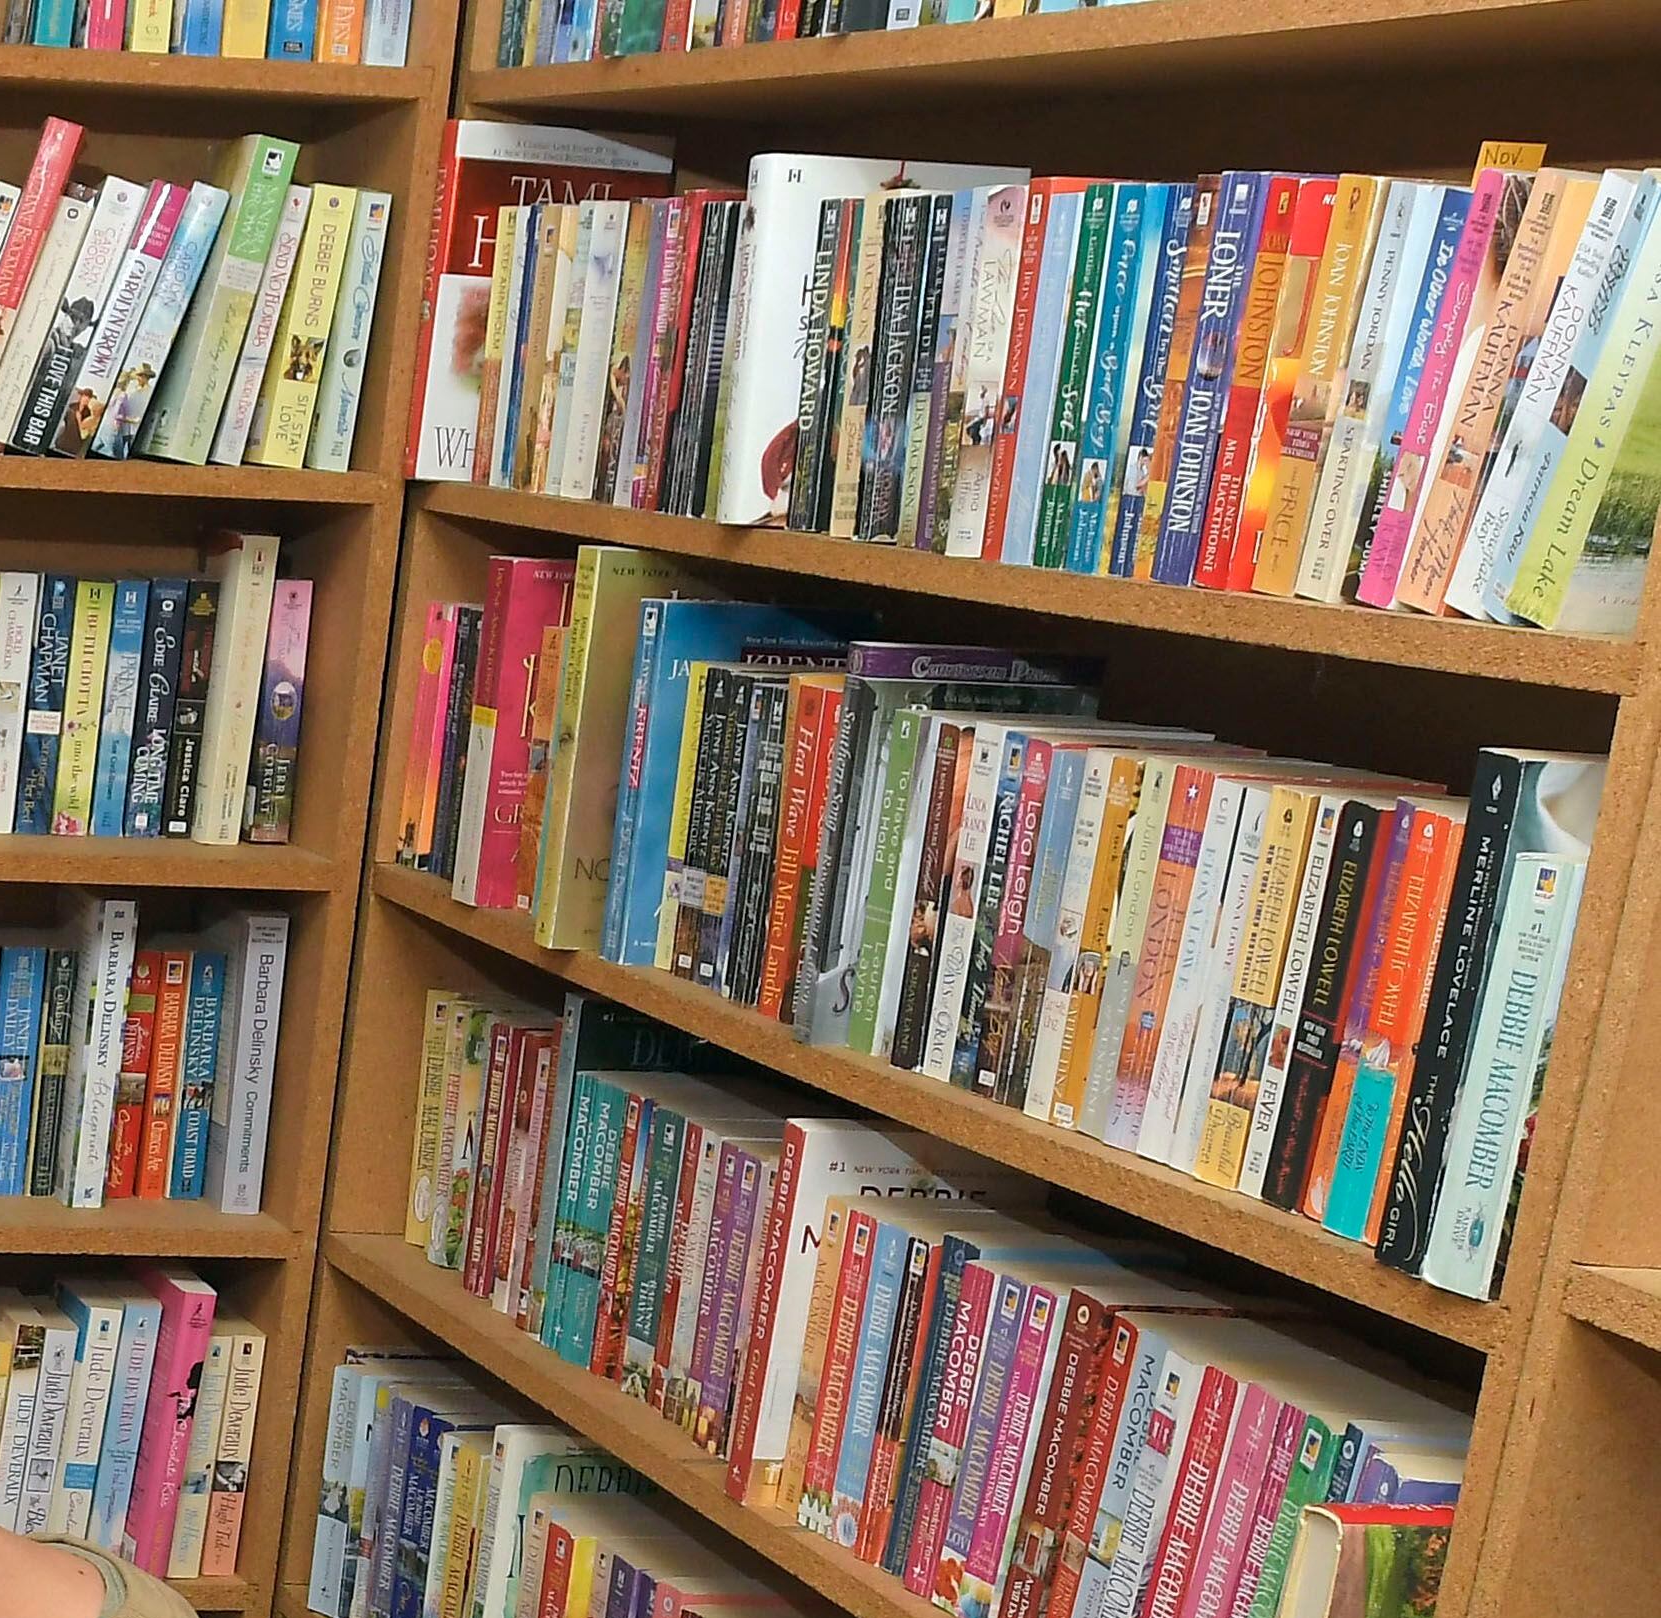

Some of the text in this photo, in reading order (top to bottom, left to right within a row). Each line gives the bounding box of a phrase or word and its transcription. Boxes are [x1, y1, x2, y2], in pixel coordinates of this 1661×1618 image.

[1484, 146, 1524, 168] Nov.
[1199, 231, 1243, 322] LONER
[1238, 255, 1274, 380] JOHNSTON
[21, 355, 71, 446] LOVE THIS BAR
[798, 250, 833, 434] LINDA HOWARD
[1459, 299, 1513, 426] KAUFFMAN
[1476, 320, 1519, 413] DONNA
[1531, 452, 1601, 602] Dream Lake
[853, 945, 872, 1016] Layne
[867, 941, 887, 1024] Lauren
[1311, 858, 1358, 1007] ELIZABETH LOWELL
[1436, 835, 1492, 1059] MERLINE LOVELACE
[95, 929, 123, 1070] BARBARA DELINSKY
[237, 951, 276, 1174] Barbara Delinsky Commitments
[1463, 968, 1539, 1191] DEBBIE MACOMBER
